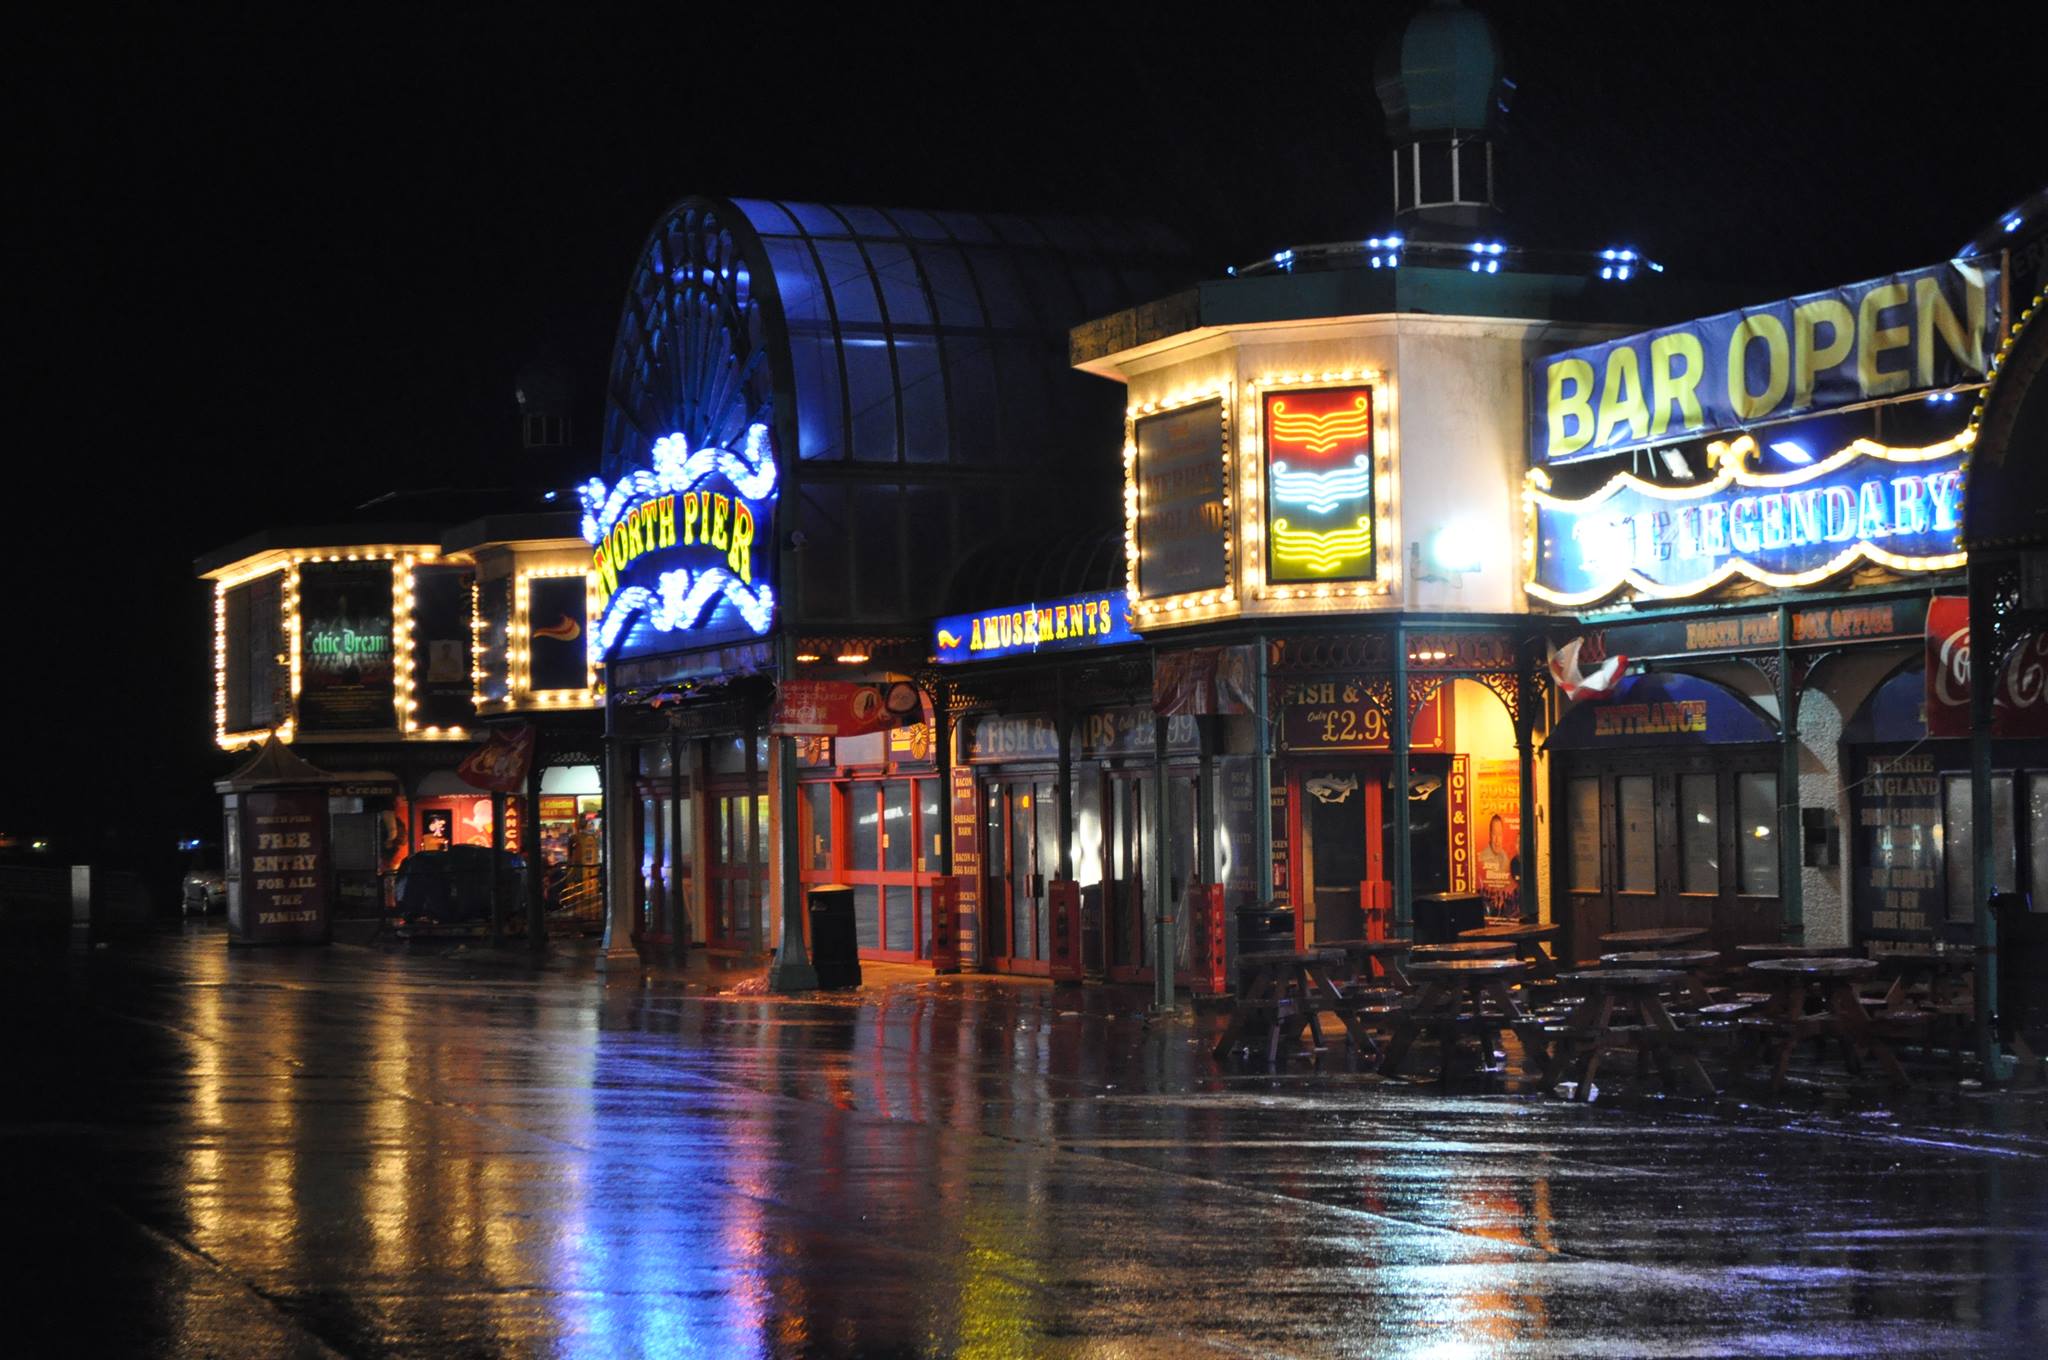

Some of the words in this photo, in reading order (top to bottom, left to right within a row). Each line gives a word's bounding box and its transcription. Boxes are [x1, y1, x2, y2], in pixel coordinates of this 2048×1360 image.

[1547, 332, 1704, 458] BAR
[1727, 268, 1986, 418] OPEN
[1677, 472, 1960, 558] LEGENDARY
[594, 495, 676, 613] NORTH
[684, 490, 754, 586] PIER
[970, 600, 1111, 650] AMUSEMENTS
[1792, 612, 1828, 640] BOX
[1831, 607, 1893, 637] OFFICE
[304, 631, 341, 653] Celtic
[1322, 709, 1391, 741] £2.9
[1594, 700, 1706, 736] ENTRANCE
[987, 718, 1028, 753] FISH
[1453, 760, 1465, 803] HOT
[1863, 777, 1941, 796] ENGLAND
[1453, 810, 1465, 824] &
[258, 832, 311, 849] FREE
[253, 855, 317, 872] ENTRY
[1454, 832, 1466, 891] COLD
[256, 879, 285, 889] FOR
[289, 877, 316, 888] ALL
[272, 895, 303, 905] THE
